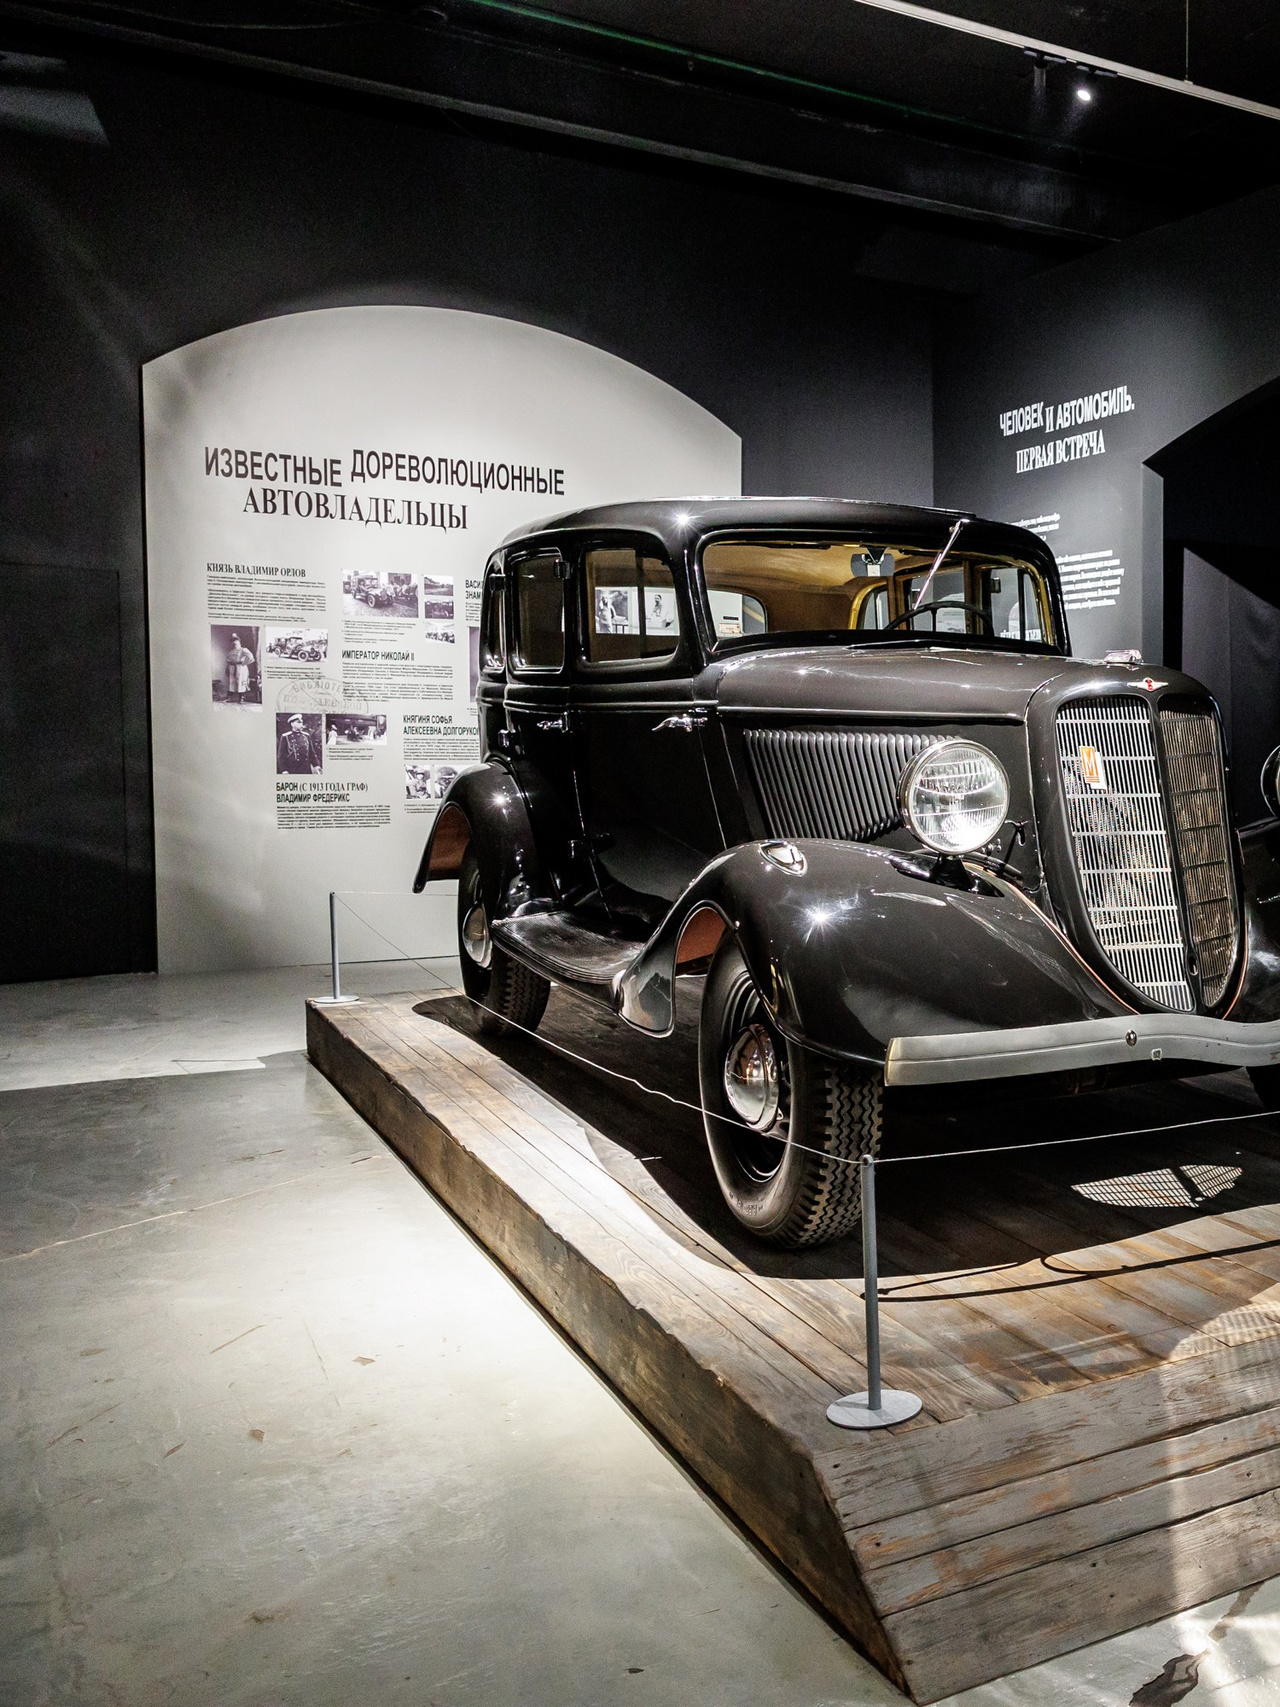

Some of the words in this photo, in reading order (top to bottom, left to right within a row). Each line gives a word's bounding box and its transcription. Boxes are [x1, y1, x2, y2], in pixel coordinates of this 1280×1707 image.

[999, 401, 1044, 437] ЧЕЛОВЕК
[1045, 405, 1054, 433] И
[1055, 385, 1135, 430] АВТОМОБИЛЬ.
[1016, 441, 1054, 474] ПЕРВАЯ
[1055, 429, 1106, 464] ВСТРЕЧА
[204, 446, 343, 487] ИЗВЕСТНЫЕ
[351, 449, 565, 496] ДОРЕВОЛЮЦИОННЫЕ
[243, 487, 468, 534] АВТОВЛАДЕЛЬЦЫ
[206, 562, 234, 574] КНЯЗЬ
[235, 564, 279, 577] ВЛАДИМИР
[280, 568, 307, 578] ОРЛОВ
[341, 650, 380, 661] ИМПЕРАТОР
[381, 650, 410, 661] НИКОЛАЙ
[403, 714, 431, 724] КНЯГИНЯ
[431, 715, 453, 724] СОФЬЯ
[403, 726, 442, 735] АЛЕКСЕЕВНА
[276, 781, 298, 792] БАРОН
[299, 782, 308, 793] (С
[309, 782, 324, 792] 1913
[325, 782, 345, 793] ГОДА
[346, 781, 369, 793] ГРАФ)
[276, 793, 312, 804] ВЛАДИМИР
[312, 792, 351, 804] ФРЕДЕРИКС
